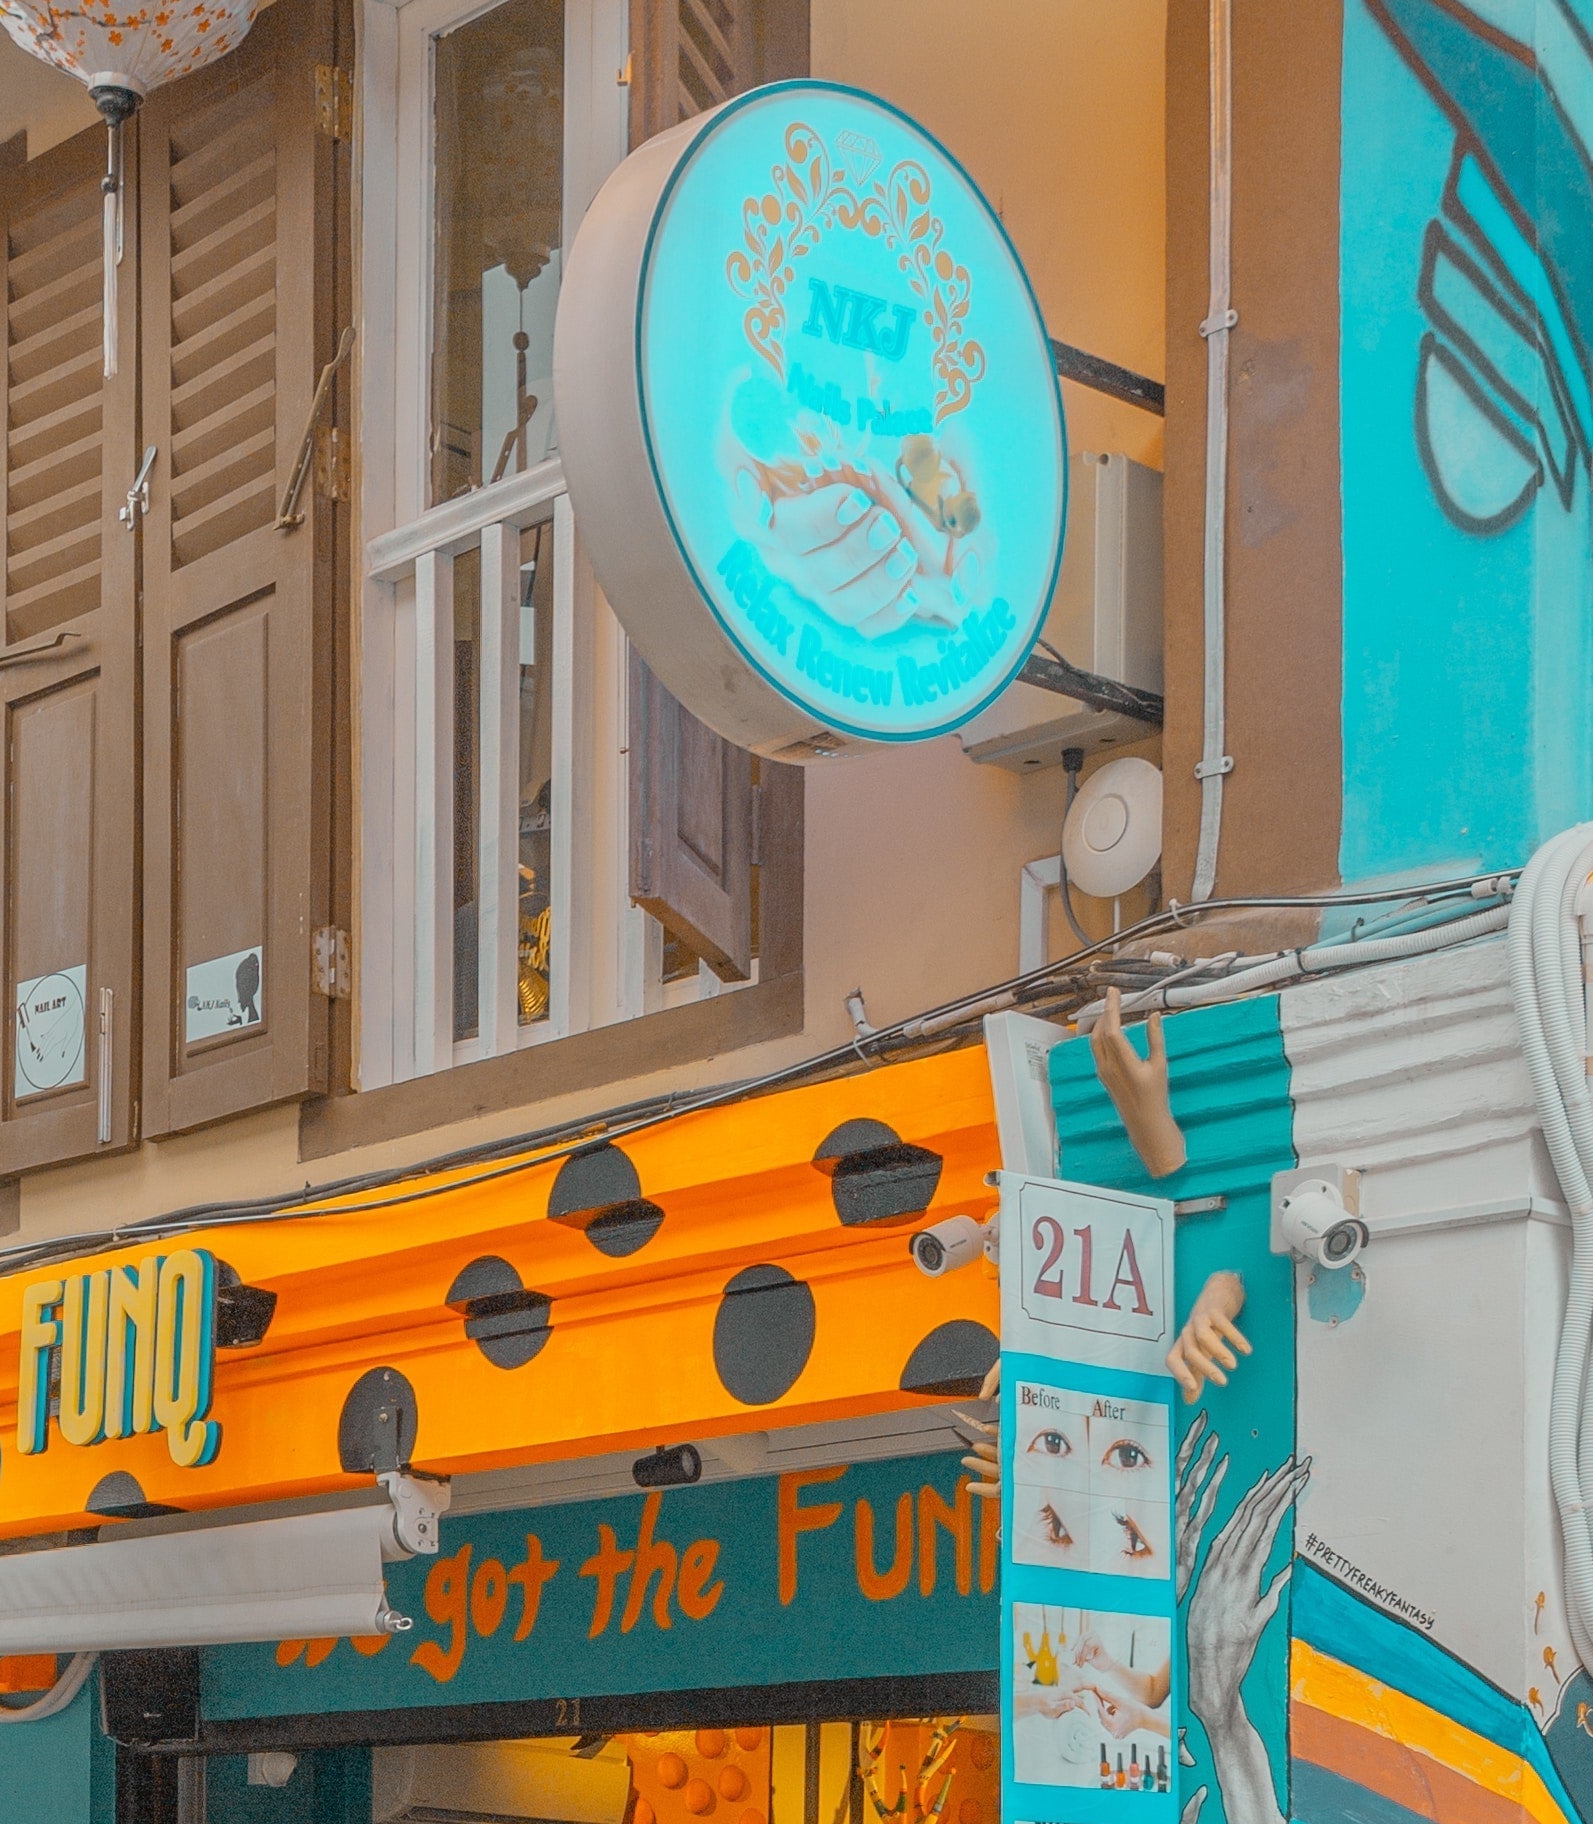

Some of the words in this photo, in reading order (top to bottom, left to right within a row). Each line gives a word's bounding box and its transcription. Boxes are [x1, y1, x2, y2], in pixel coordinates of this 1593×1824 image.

[802, 278, 917, 363] NKJ
[717, 538, 796, 655] Relax
[796, 624, 892, 708] Renew
[1031, 1215, 1154, 1317] 21A
[18, 1248, 220, 1468] FUNQ
[1020, 1386, 1060, 1410] Before
[1091, 1399, 1126, 1420] After
[411, 1533, 559, 1683] got
[580, 1492, 725, 1638] the
[1305, 1533, 1435, 1630] #PRETTYFREAKYFANTASY
